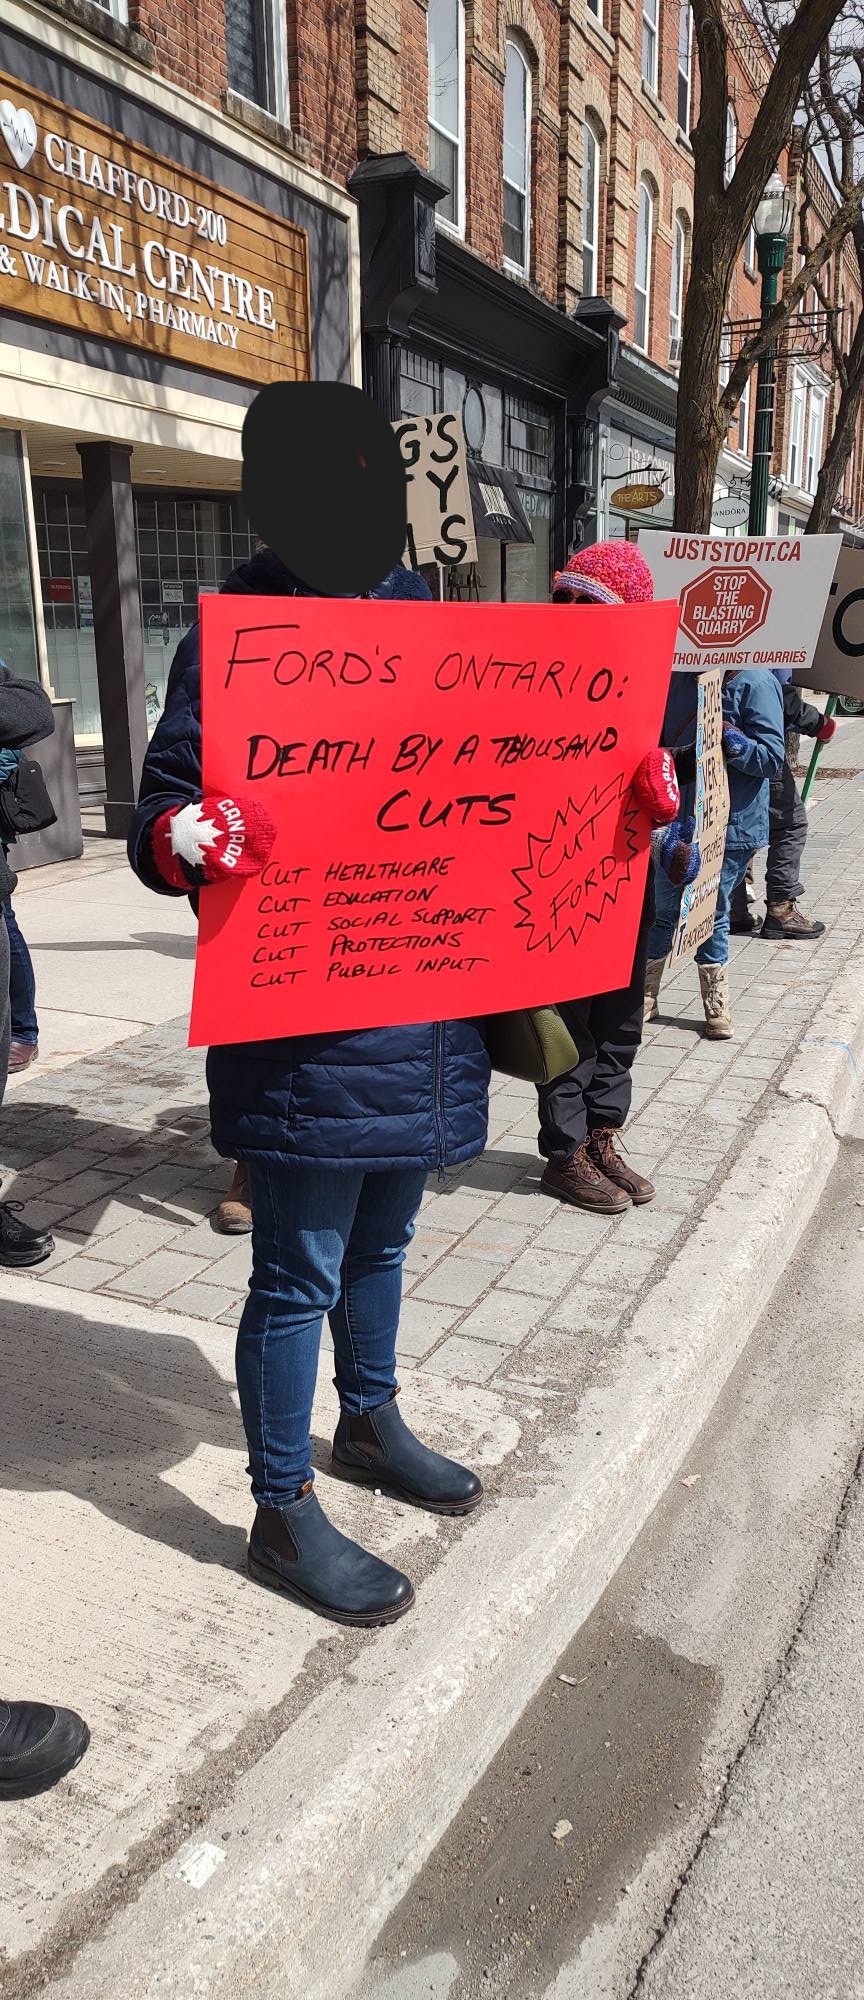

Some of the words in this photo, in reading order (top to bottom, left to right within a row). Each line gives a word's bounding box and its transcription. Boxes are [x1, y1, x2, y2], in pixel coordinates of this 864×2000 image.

[45, 133, 228, 246] CHAFFORD-200
[0, 181, 136, 279] DICAL
[143, 240, 277, 331] CENTRE
[0, 244, 18, 277] &
[22, 250, 133, 323] WALK-IN,
[135, 290, 240, 349] PHARMACY
[713, 507, 747, 517] ANDORA
[664, 537, 801, 562] JUSTSTOPIT.CA
[713, 575, 747, 591] STOP
[716, 591, 740, 605] THE
[692, 604, 755, 620] BLASTING
[696, 620, 747, 635] QUARRY
[225, 624, 401, 688] FORD'S
[435, 653, 629, 702] ONTARIO:
[703, 651, 751, 664] AGAINST
[753, 650, 806, 664] QUARRIES
[246, 735, 375, 780] DEATH
[391, 734, 444, 775] BY
[454, 735, 479, 766] A
[491, 727, 618, 767] THOUSAND
[377, 789, 516, 832] CUTS
[217, 799, 246, 868] CANADA
[538, 790, 622, 879] CUT
[261, 862, 310, 886] CUT
[325, 857, 455, 882] HEALTHCARE
[258, 892, 310, 913] CUT
[323, 885, 438, 906] EDUCATION
[551, 855, 616, 930] FORD
[257, 921, 310, 939] CUT
[327, 912, 401, 930] SOCIAL
[412, 907, 495, 926] SUPPORT
[252, 945, 307, 963] CUT
[330, 931, 462, 956] PROTECTIONS
[251, 969, 307, 987] CUT
[327, 962, 401, 981] PUBLIC
[415, 957, 489, 973] INPUT
